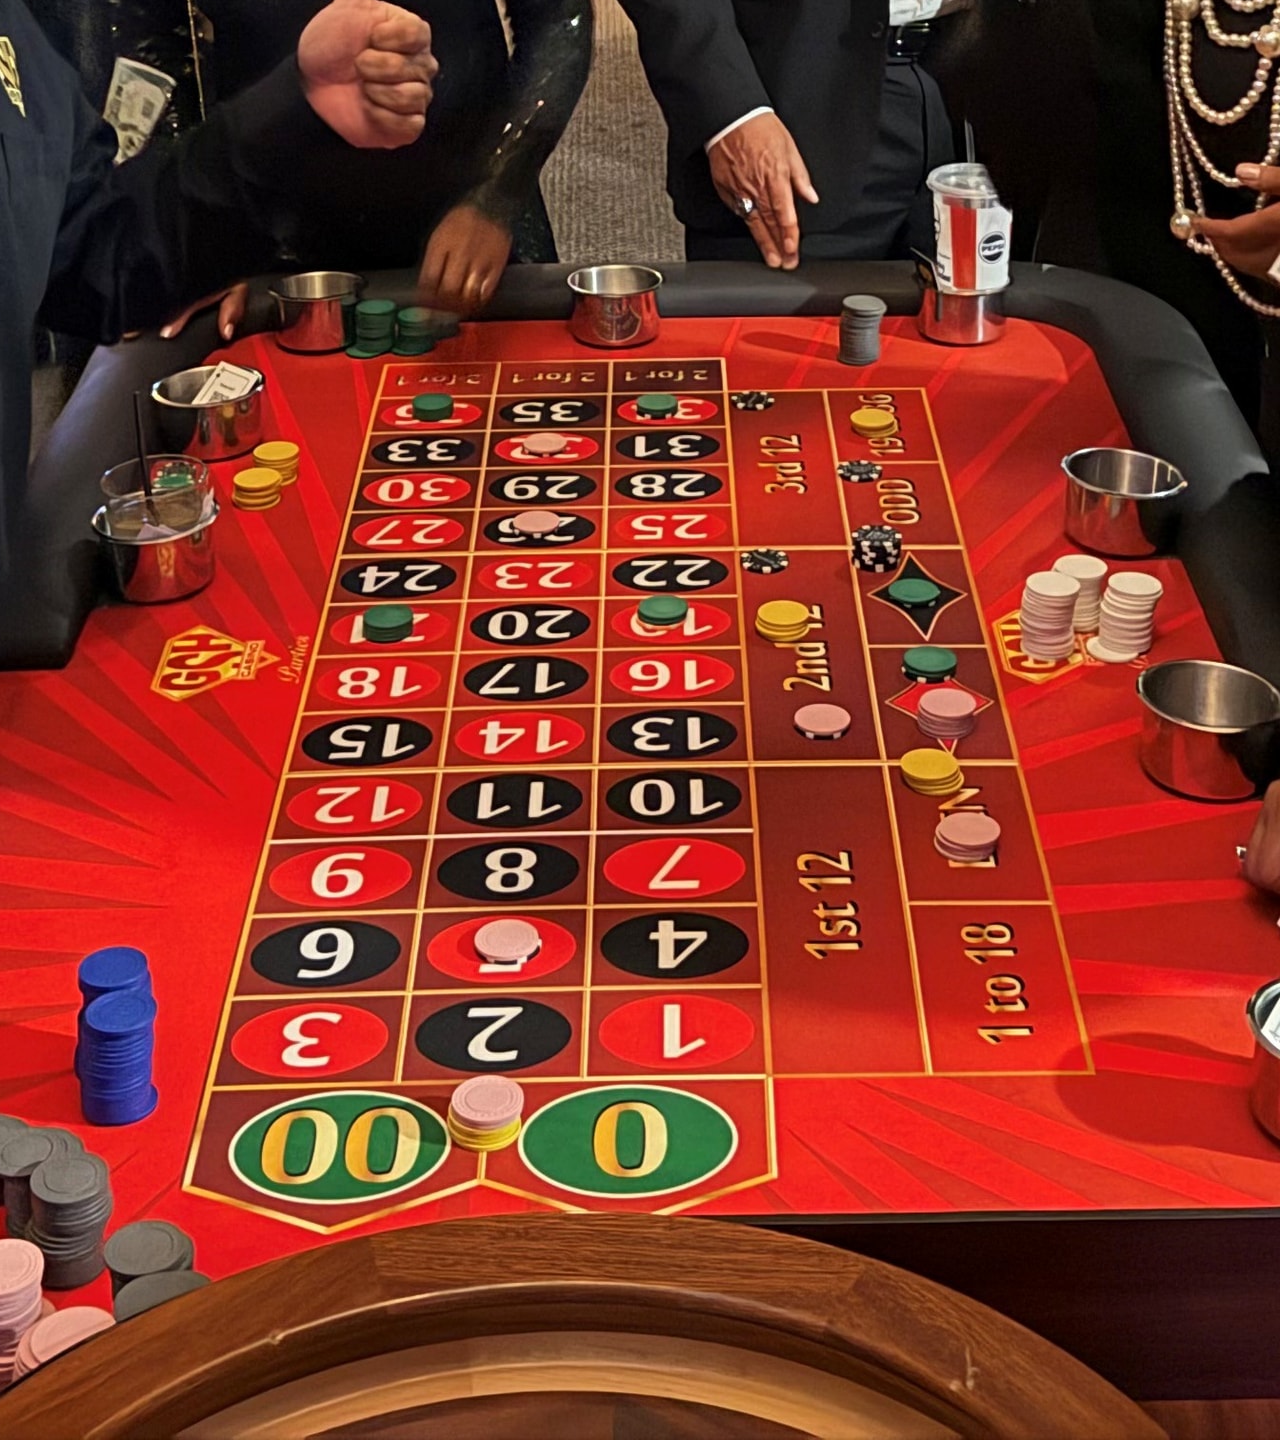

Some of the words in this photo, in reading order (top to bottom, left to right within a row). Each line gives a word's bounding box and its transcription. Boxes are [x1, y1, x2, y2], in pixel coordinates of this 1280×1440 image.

[512, 372, 521, 384] 1
[533, 371, 571, 383] for
[580, 371, 596, 383] 2
[624, 370, 634, 382] 1
[646, 369, 684, 382] for
[692, 369, 708, 382] 2
[512, 401, 583, 423] 35
[387, 439, 461, 462] 33
[634, 434, 702, 458] 31
[759, 433, 802, 457] 12
[377, 477, 456, 502] 30
[503, 475, 580, 500] 29
[630, 473, 706, 498] 28
[757, 461, 806, 495] 3rd
[875, 478, 921, 525] ODD
[366, 519, 448, 545] 27
[631, 514, 707, 540] 25
[359, 564, 442, 593] 24
[495, 561, 574, 589] 23
[630, 559, 711, 587] 22
[488, 609, 573, 640] 20
[337, 666, 421, 699] 18
[478, 662, 566, 695] 17
[629, 660, 715, 692] 16
[773, 641, 832, 692] 2nd
[328, 723, 415, 760] 15
[479, 719, 568, 754] 14
[631, 717, 720, 752] 13
[315, 786, 405, 824] 12
[476, 781, 562, 819] 11
[630, 778, 723, 816] 10
[311, 852, 365, 899] 9
[485, 847, 537, 893] 8
[648, 845, 700, 890] 7
[796, 850, 853, 893] 12
[649, 920, 708, 969] 4
[803, 900, 862, 960] 1st
[960, 922, 1017, 965] 18
[296, 927, 355, 979] 6
[984, 973, 1028, 1014] to
[281, 1011, 342, 1068] 3
[467, 1006, 524, 1062] 2
[663, 1004, 706, 1059] 1
[976, 1025, 1034, 1046] 1
[259, 1105, 422, 1186] 00
[592, 1100, 670, 1179] 0
